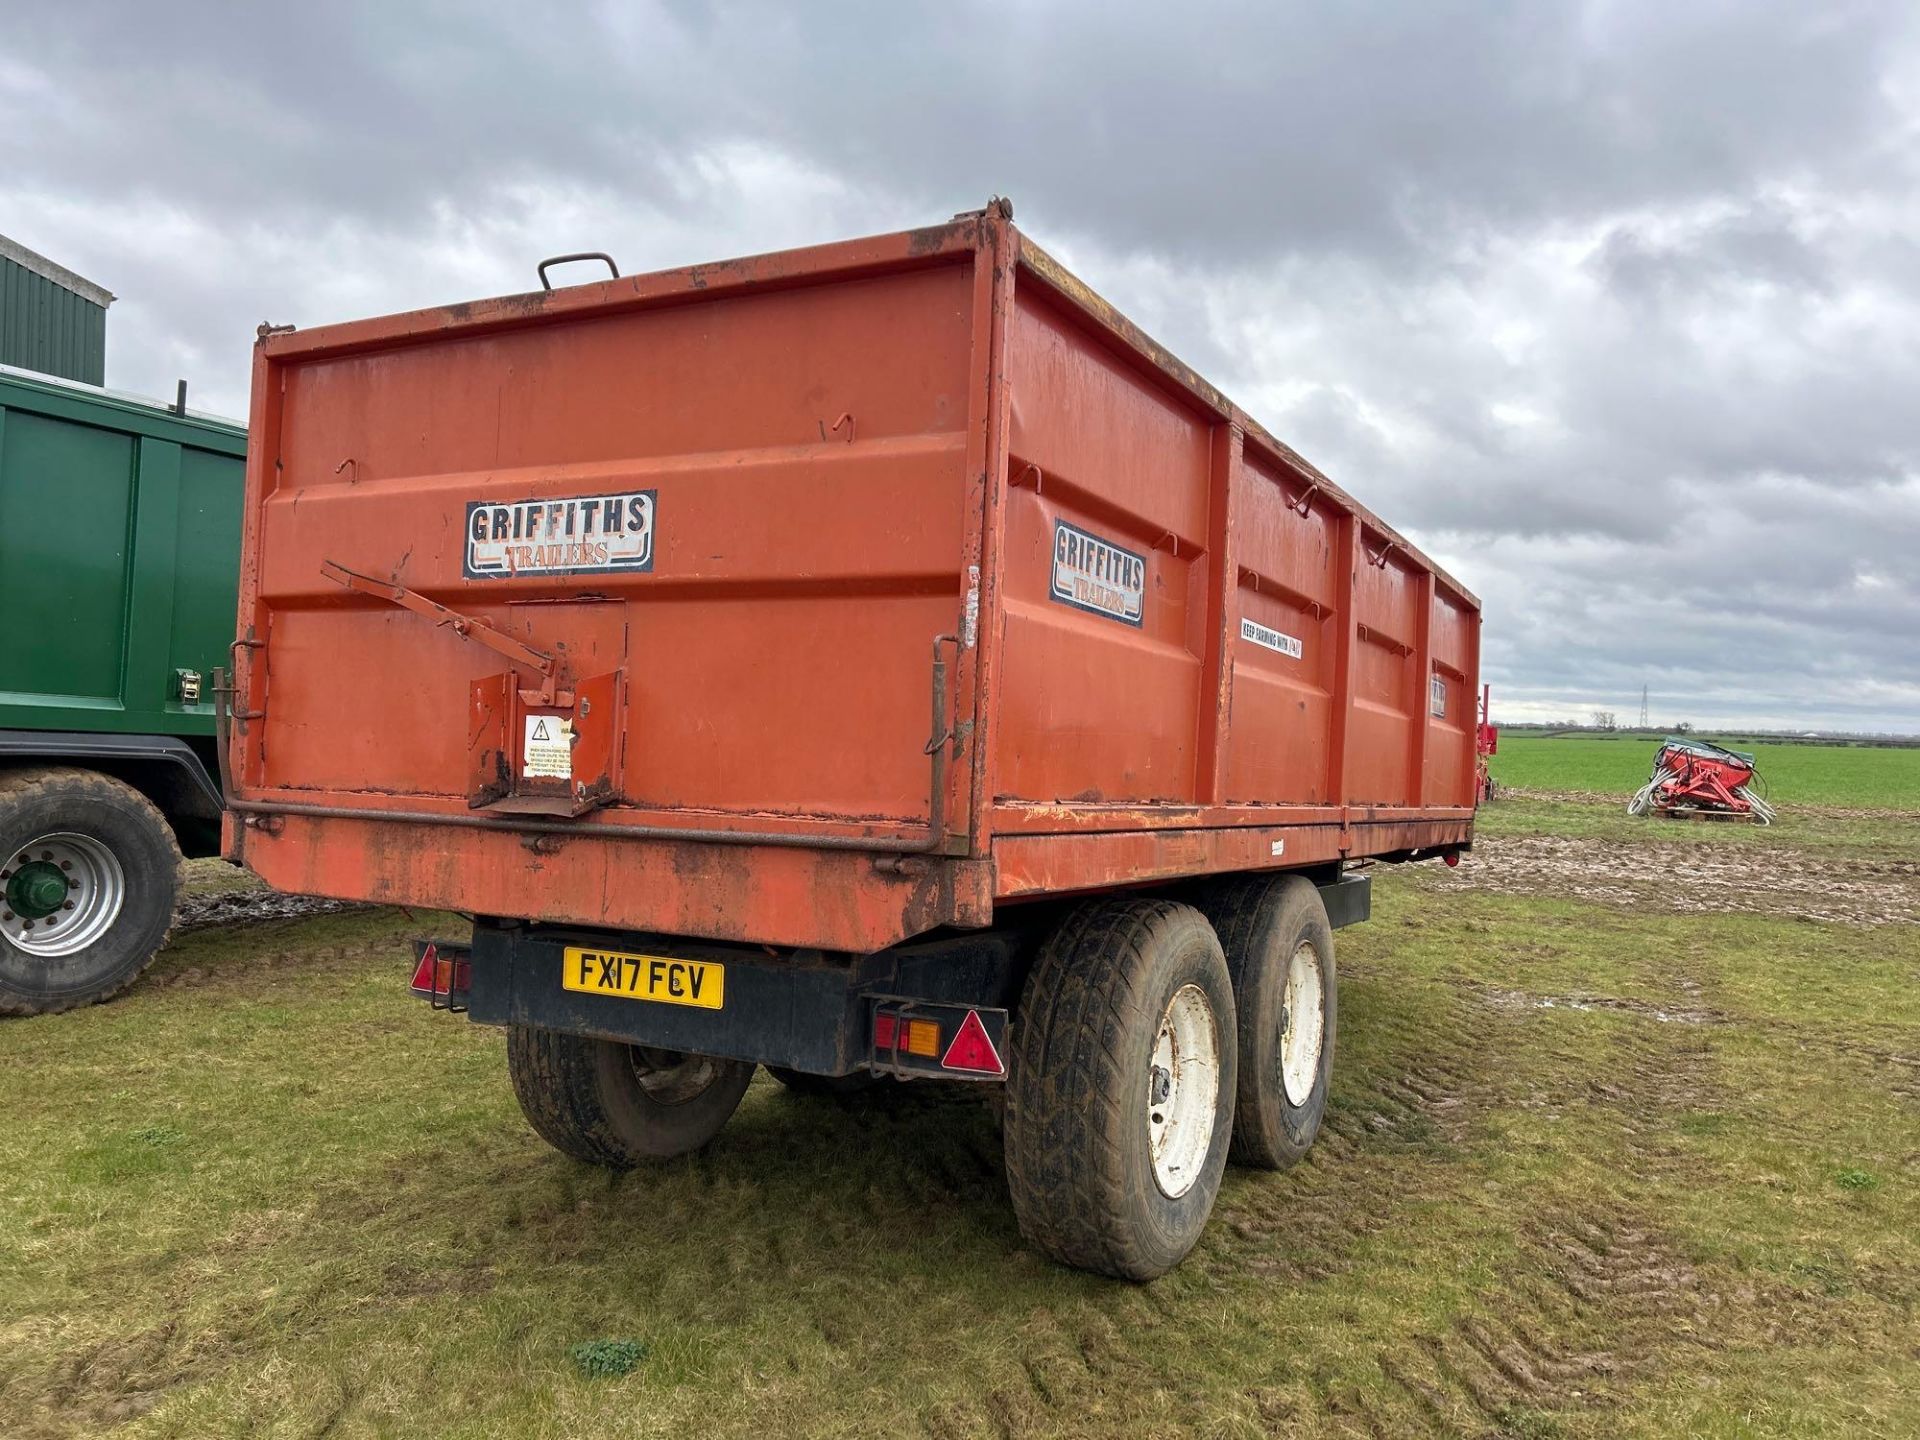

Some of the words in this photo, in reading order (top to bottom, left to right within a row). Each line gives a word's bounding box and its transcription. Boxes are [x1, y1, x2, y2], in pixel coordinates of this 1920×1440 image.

[472, 497, 647, 543] GRIFFITHS
[505, 541, 608, 569] TRAILERS
[1056, 528, 1141, 592] GRIFFITHS
[1243, 622, 1256, 639] KEEP
[579, 953, 641, 991] FX17
[649, 961, 705, 999] FCV
